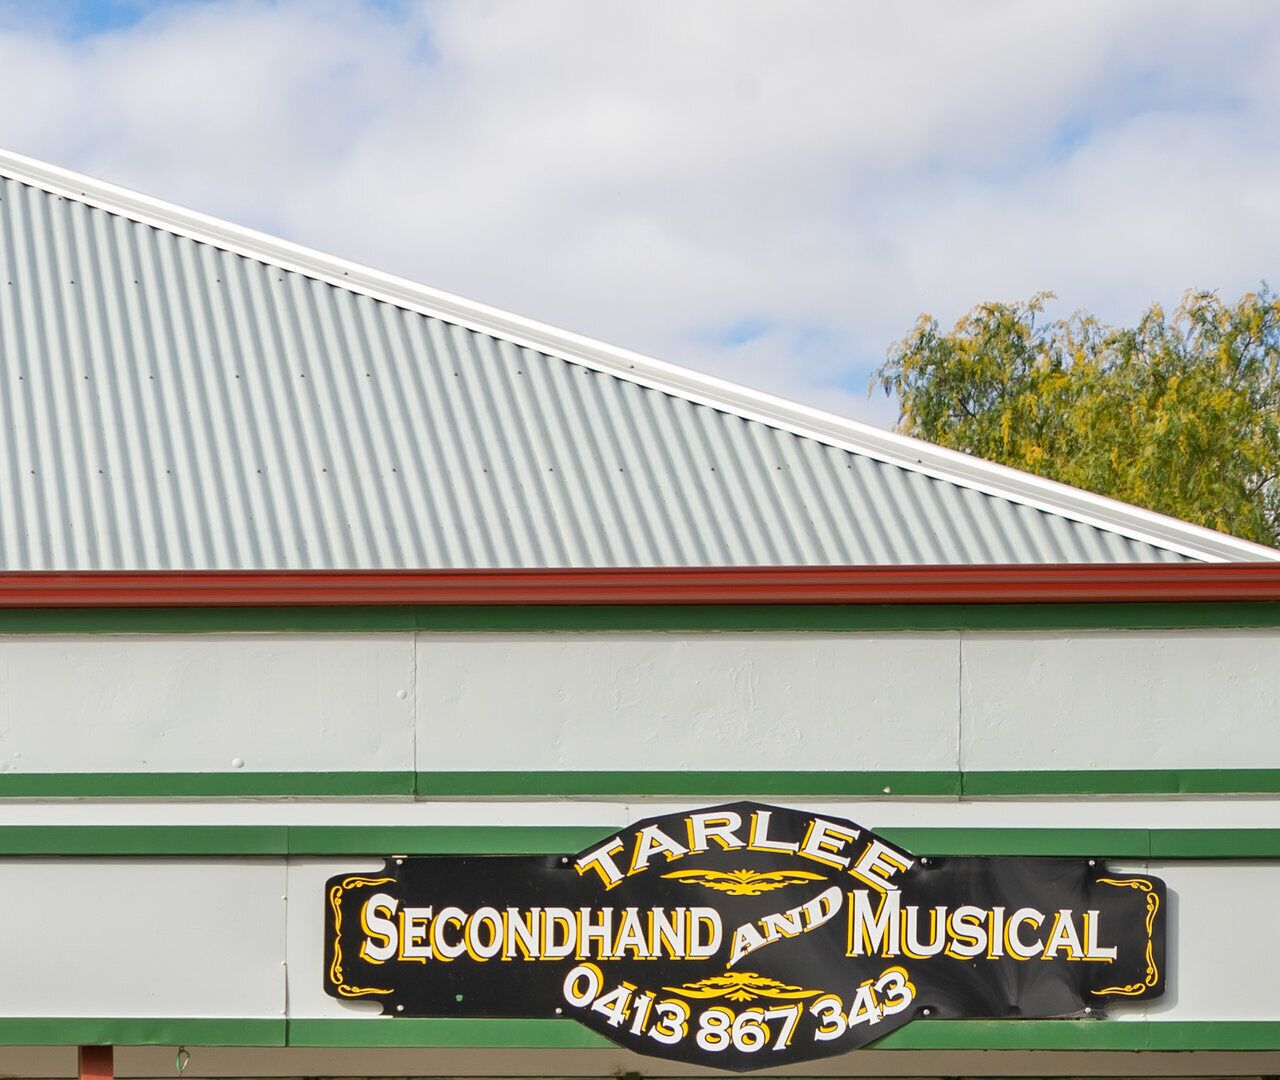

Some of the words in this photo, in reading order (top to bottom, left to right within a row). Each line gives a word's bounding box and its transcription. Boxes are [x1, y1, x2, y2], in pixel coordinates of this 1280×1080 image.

[574, 809, 914, 893] TARLEE
[361, 892, 723, 963] SECONDHAND
[727, 885, 843, 968] AND
[847, 889, 1119, 963] MUSICAL
[562, 964, 688, 1046] 0413
[696, 1007, 798, 1053] 867
[812, 964, 918, 1044] 343
